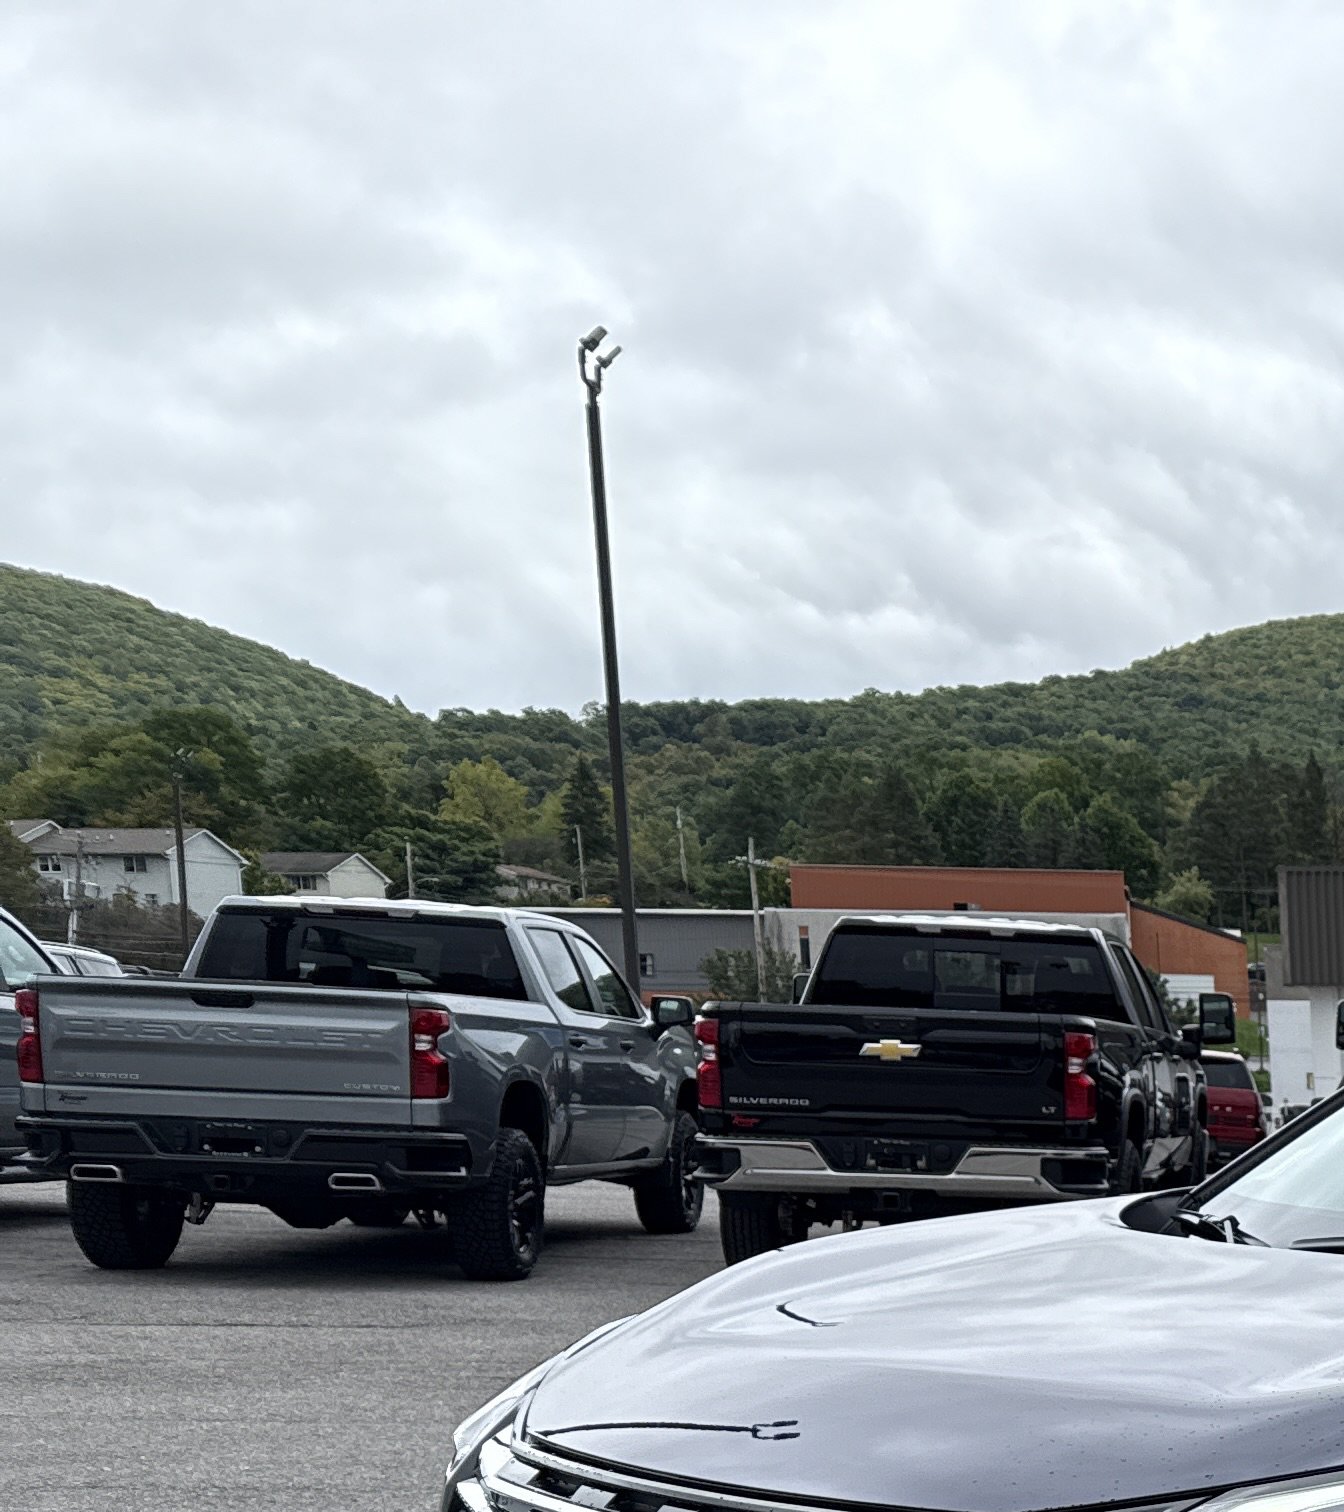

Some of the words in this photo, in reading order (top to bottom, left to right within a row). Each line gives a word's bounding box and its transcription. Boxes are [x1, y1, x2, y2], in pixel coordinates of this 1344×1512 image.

[62, 1017, 385, 1049] CHEVROLET
[343, 1082, 401, 1092] CUSTOM
[728, 1095, 810, 1106] SILVERADO
[1041, 1105, 1057, 1115] LT
